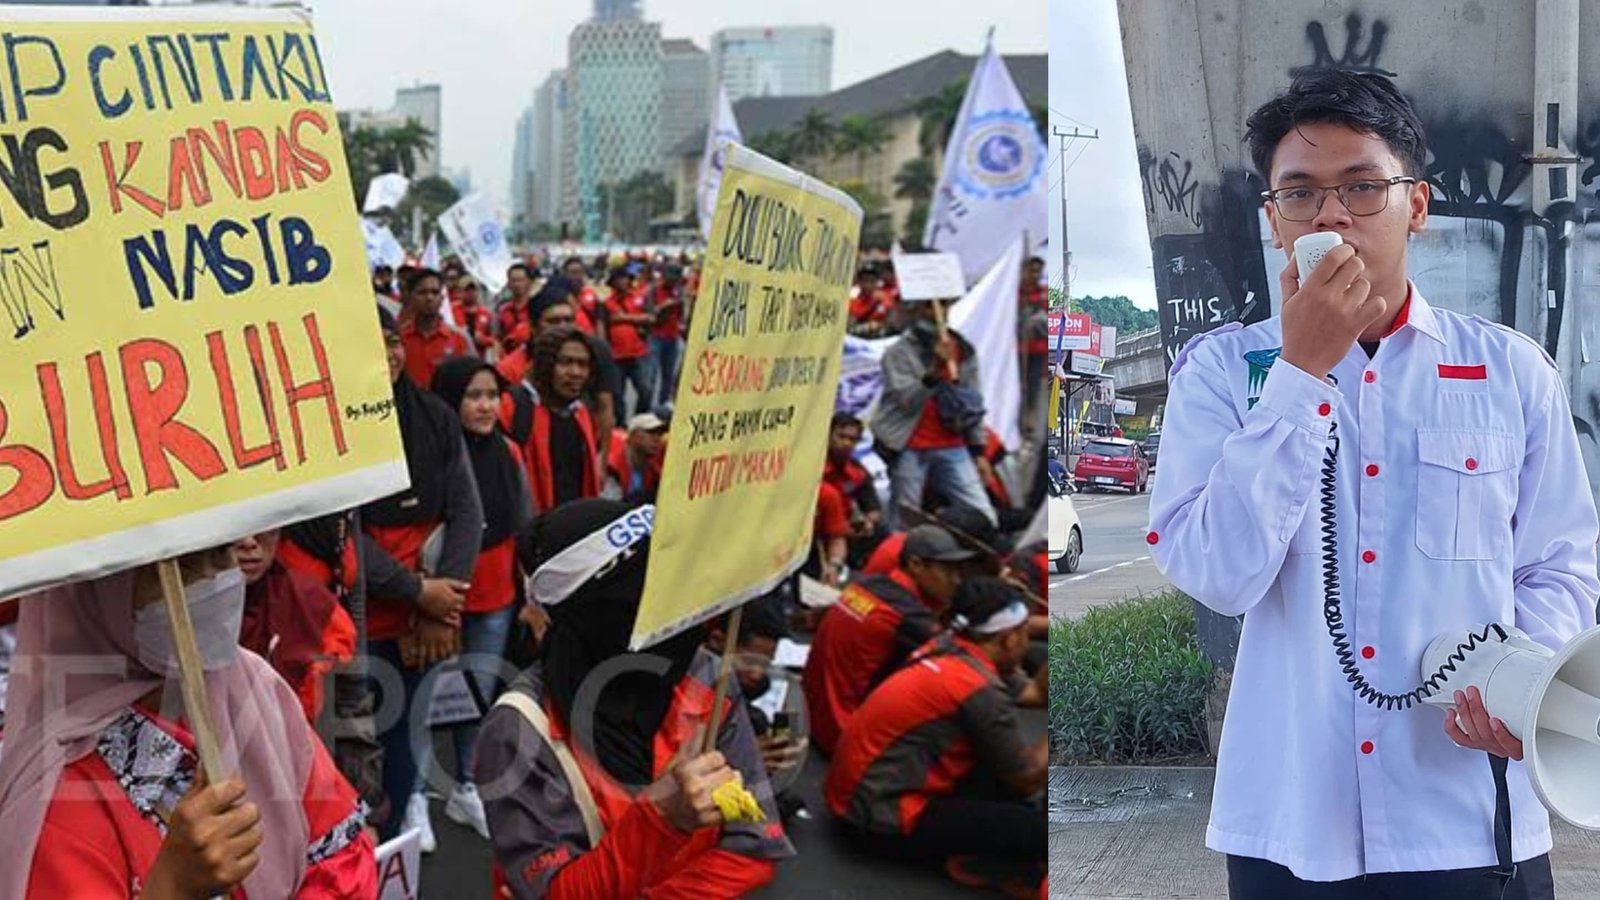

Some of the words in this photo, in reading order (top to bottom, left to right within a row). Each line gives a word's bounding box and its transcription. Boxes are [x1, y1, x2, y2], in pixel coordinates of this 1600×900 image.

[0, 32, 67, 123] P
[87, 30, 333, 119] CINTAKU
[98, 109, 332, 219] KANDAS
[123, 212, 332, 309] NASIB
[708, 278, 751, 341] UPAH
[1167, 297, 1221, 326] THIS
[692, 350, 768, 395] SEKARANG
[689, 410, 729, 450] YANG
